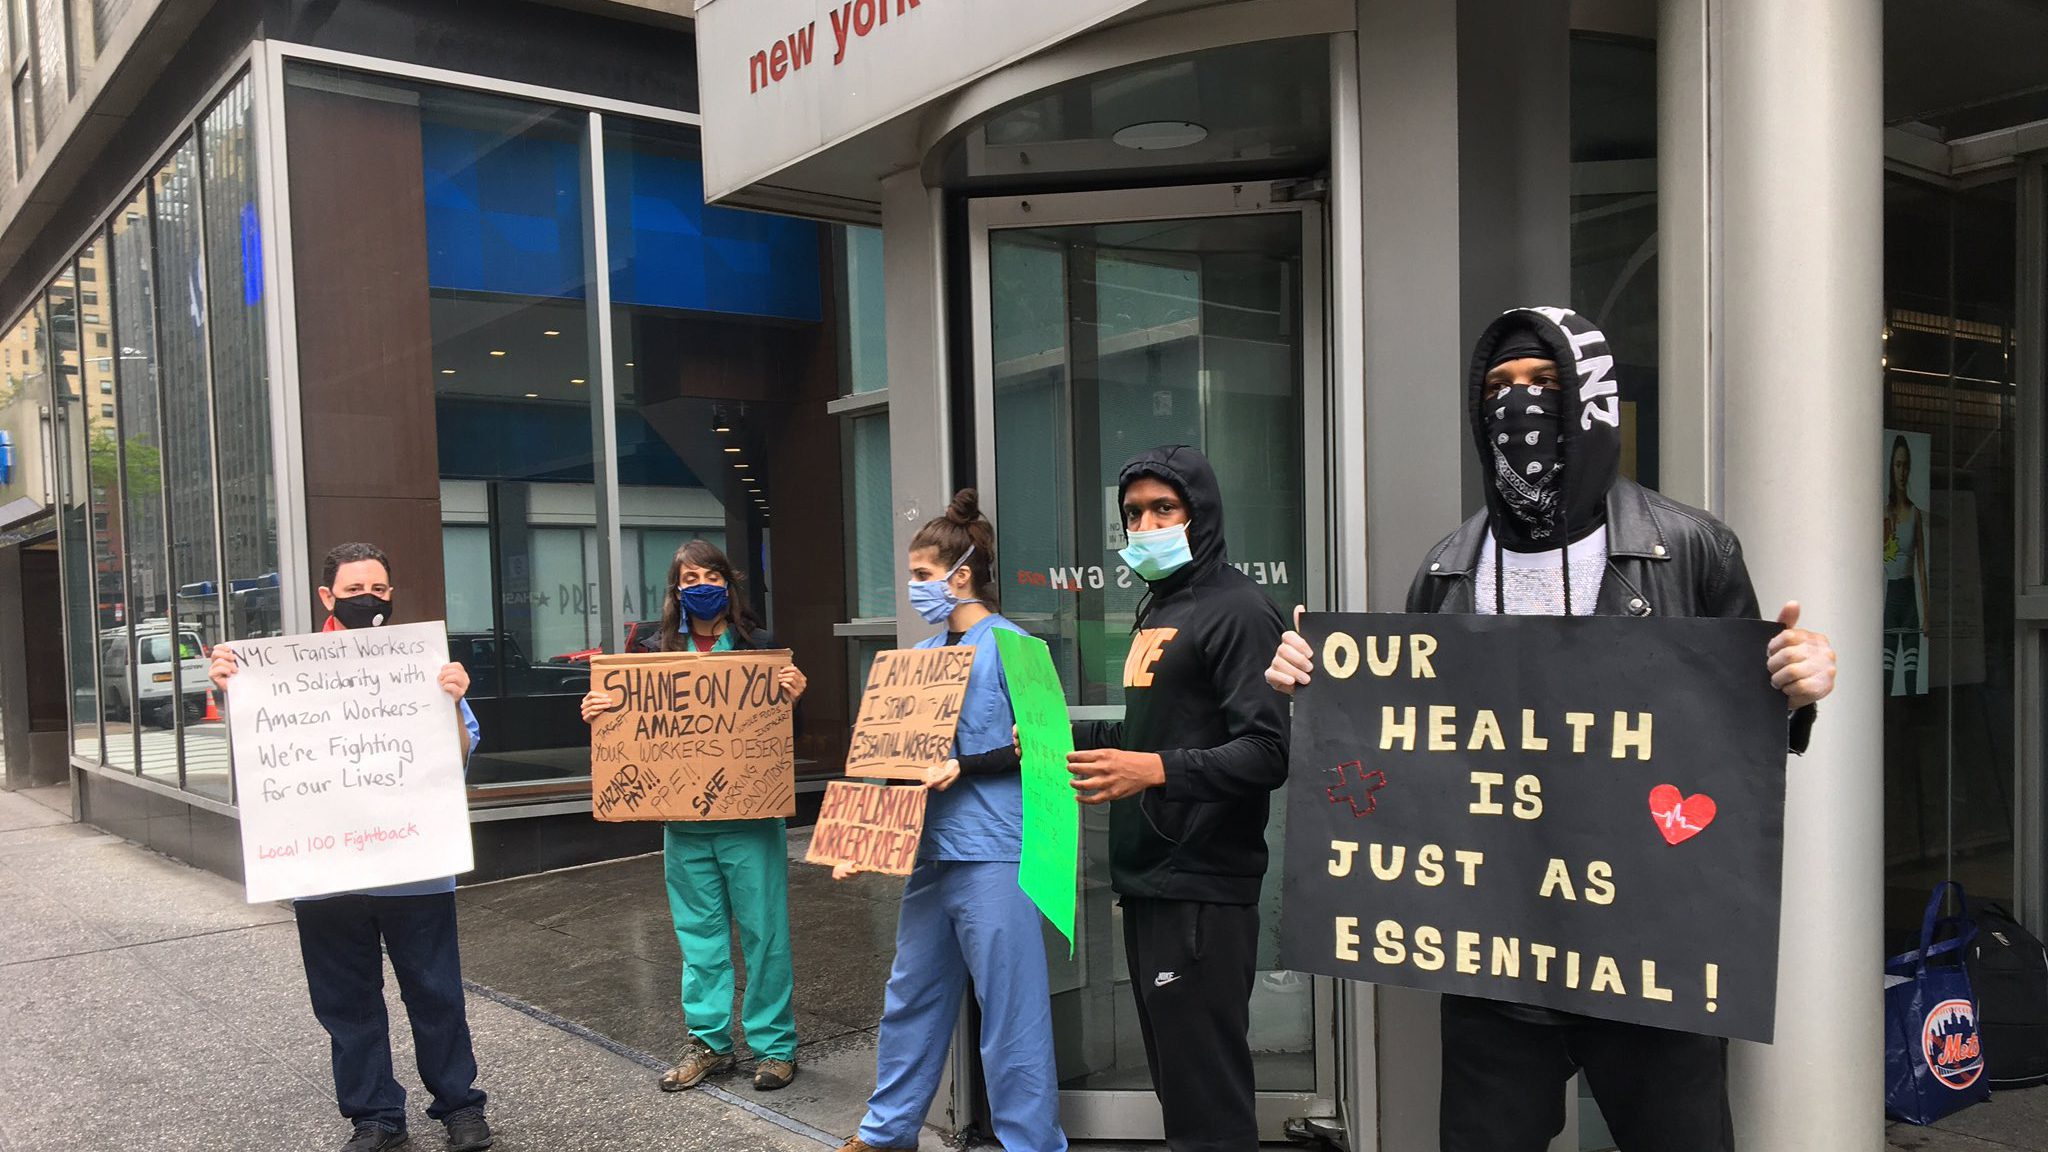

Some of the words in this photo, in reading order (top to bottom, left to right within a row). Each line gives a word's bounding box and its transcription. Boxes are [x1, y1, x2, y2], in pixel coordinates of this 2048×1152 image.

[750, 20, 815, 94] new
[233, 647, 277, 667] NYC
[285, 641, 347, 663] Transit
[353, 636, 425, 658] Workers
[868, 655, 888, 690] I
[884, 655, 911, 687] AM
[910, 654, 925, 685] A
[923, 651, 972, 684] NURSE
[1322, 631, 1438, 680] OUR
[271, 673, 291, 697] in
[296, 667, 380, 696] Solidarity
[390, 663, 425, 685] with
[603, 668, 691, 713] SHAME
[695, 671, 731, 709] ON
[738, 664, 789, 711] YOU
[256, 707, 331, 733] Amazon
[596, 707, 631, 740] TARGET
[634, 711, 736, 741] AMAZON
[863, 695, 880, 722] I
[934, 693, 959, 720] ALL
[258, 743, 317, 768] We're
[329, 733, 414, 764] Fighting
[594, 741, 630, 763] YOUR
[640, 740, 725, 763] WORKERS
[731, 736, 794, 759] DESERVE
[1379, 705, 1653, 761] HEALTH
[261, 778, 290, 803] for
[297, 779, 331, 796] our
[342, 761, 404, 788] Lives!
[594, 764, 639, 818] HAZARD
[692, 767, 729, 817] SAFE
[717, 763, 757, 814] WORKING
[737, 757, 792, 816] CONDITIONS
[1469, 771, 1543, 821] IS
[259, 840, 298, 860] Local
[308, 836, 335, 852] 100
[344, 822, 419, 850] Fightback
[1328, 839, 1484, 887] JUST
[1539, 858, 1616, 906] AS
[1938, 1032, 1980, 1066] Mets
